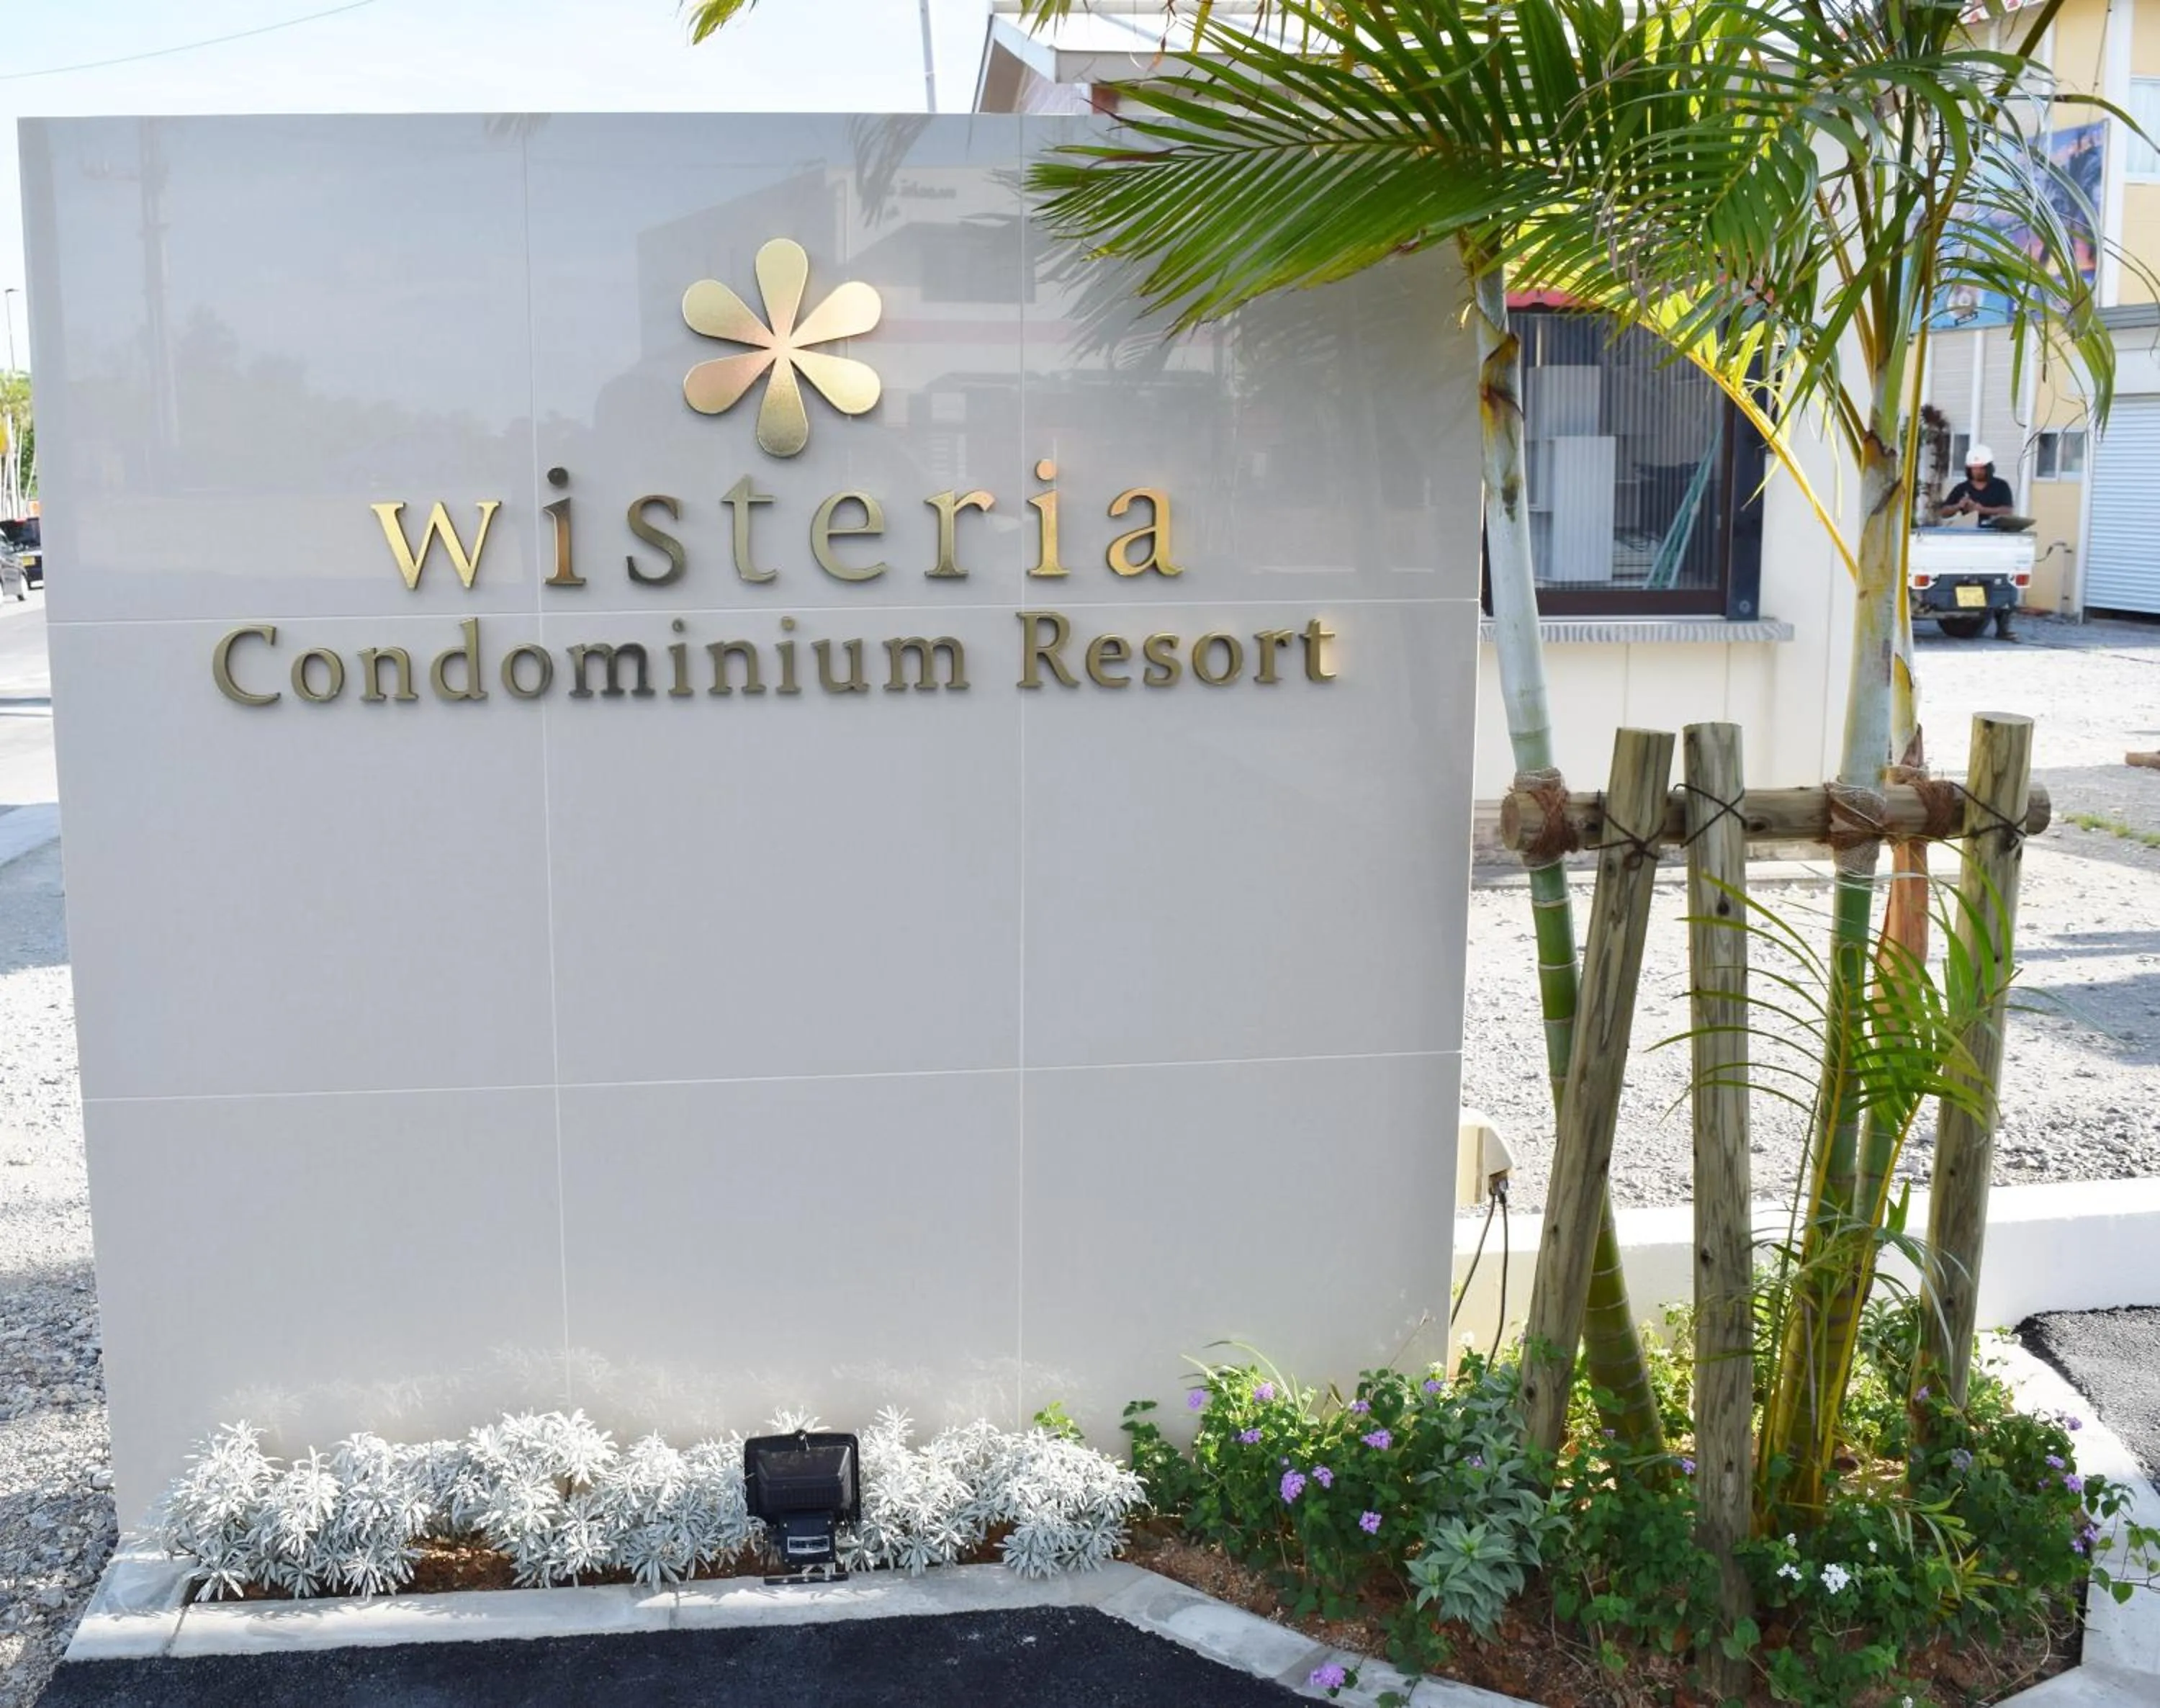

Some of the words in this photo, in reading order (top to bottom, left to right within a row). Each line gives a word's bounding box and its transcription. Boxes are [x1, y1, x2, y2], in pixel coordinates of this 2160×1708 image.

[370, 459, 1185, 589] wisteria
[213, 617, 970, 706] Condominium
[1015, 611, 1336, 689] Resort
